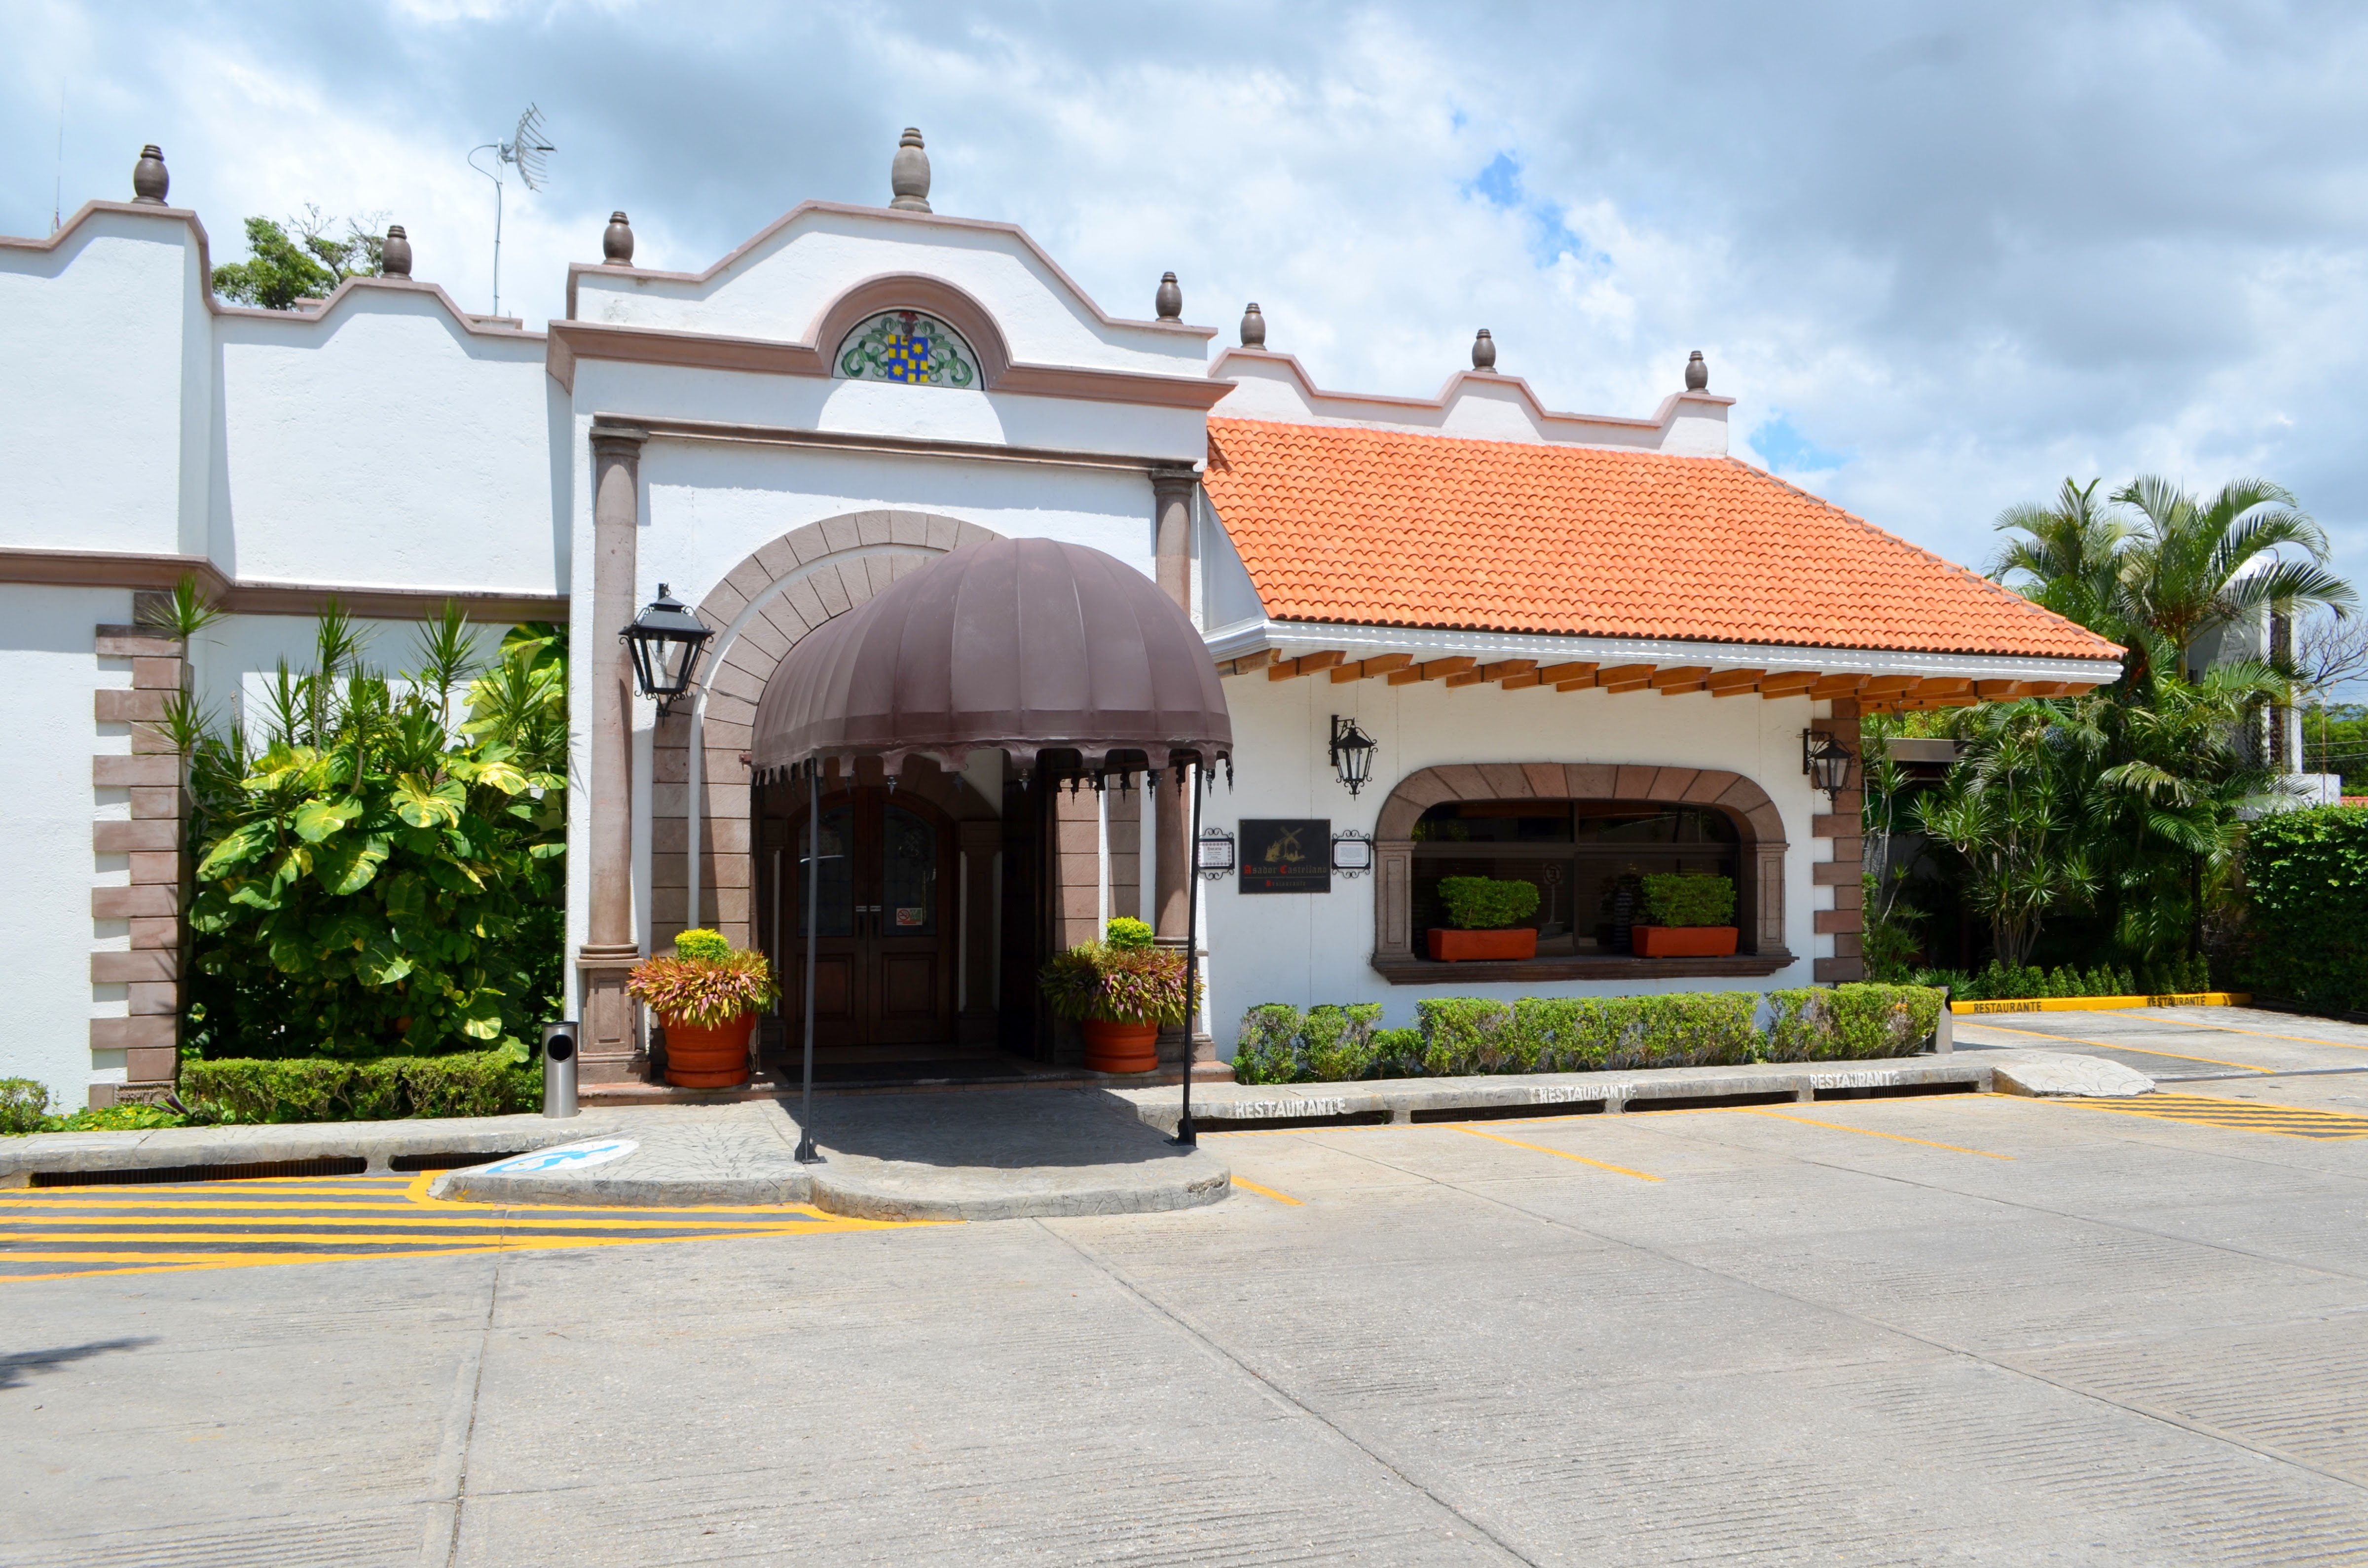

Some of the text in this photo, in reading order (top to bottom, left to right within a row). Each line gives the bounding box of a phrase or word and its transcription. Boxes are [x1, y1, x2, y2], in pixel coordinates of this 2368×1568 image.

[1244, 864, 1327, 875] Asador Castellano
[1973, 1001, 2042, 1014] RESTAURANTE
[2147, 995, 2206, 1007] RESTAURANTE
[1809, 1071, 1899, 1089] RESTAURANTE
[1235, 1097, 1346, 1119] RESTAURANTE
